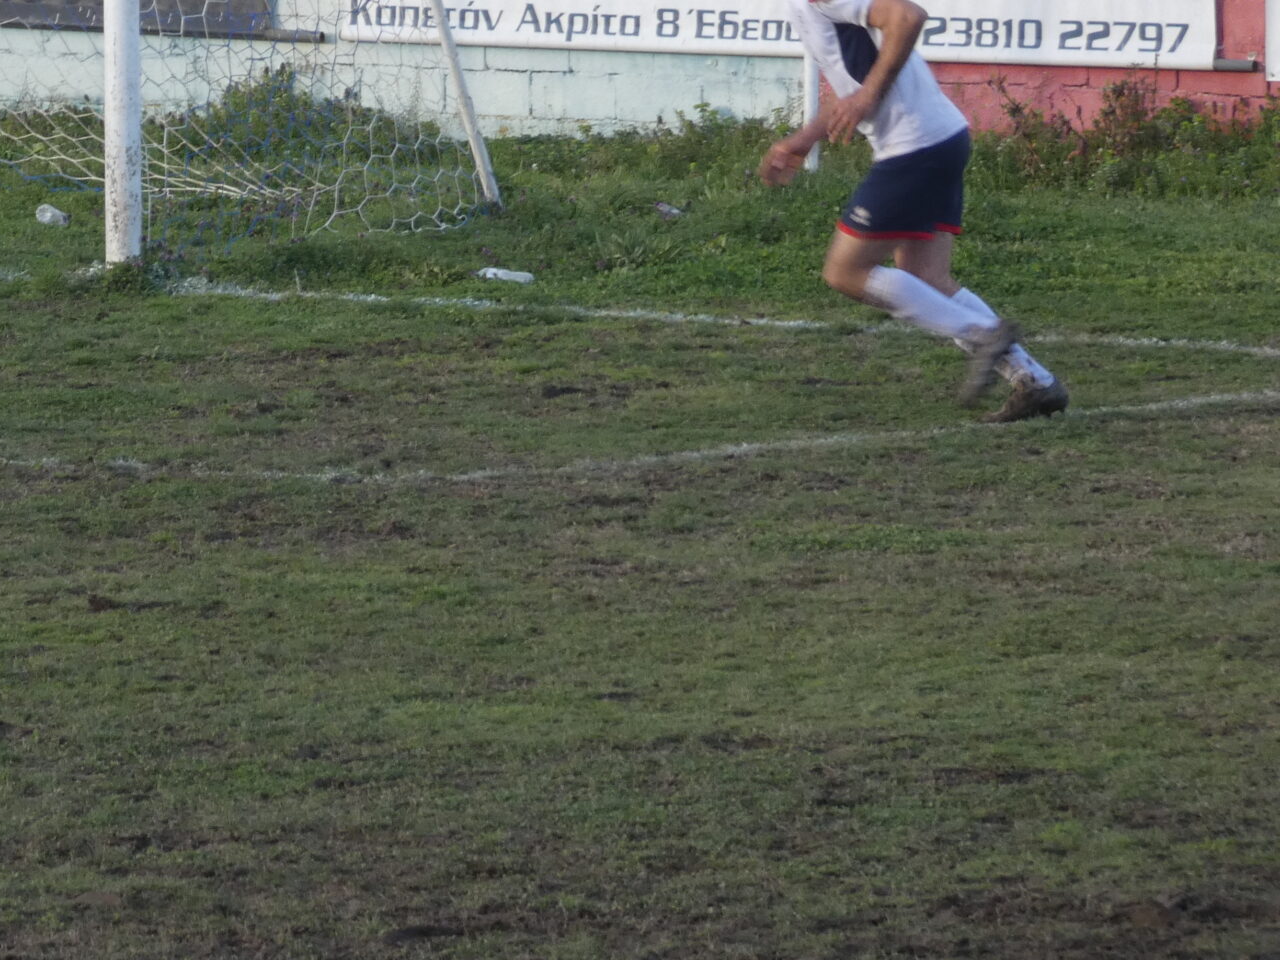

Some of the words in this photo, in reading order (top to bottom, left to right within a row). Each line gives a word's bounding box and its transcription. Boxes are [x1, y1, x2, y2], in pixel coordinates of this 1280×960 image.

[516, 2, 641, 42] Ακρίτα
[655, 7, 681, 38] 8
[922, 16, 1042, 49] 23810
[1058, 20, 1190, 53] 22797
